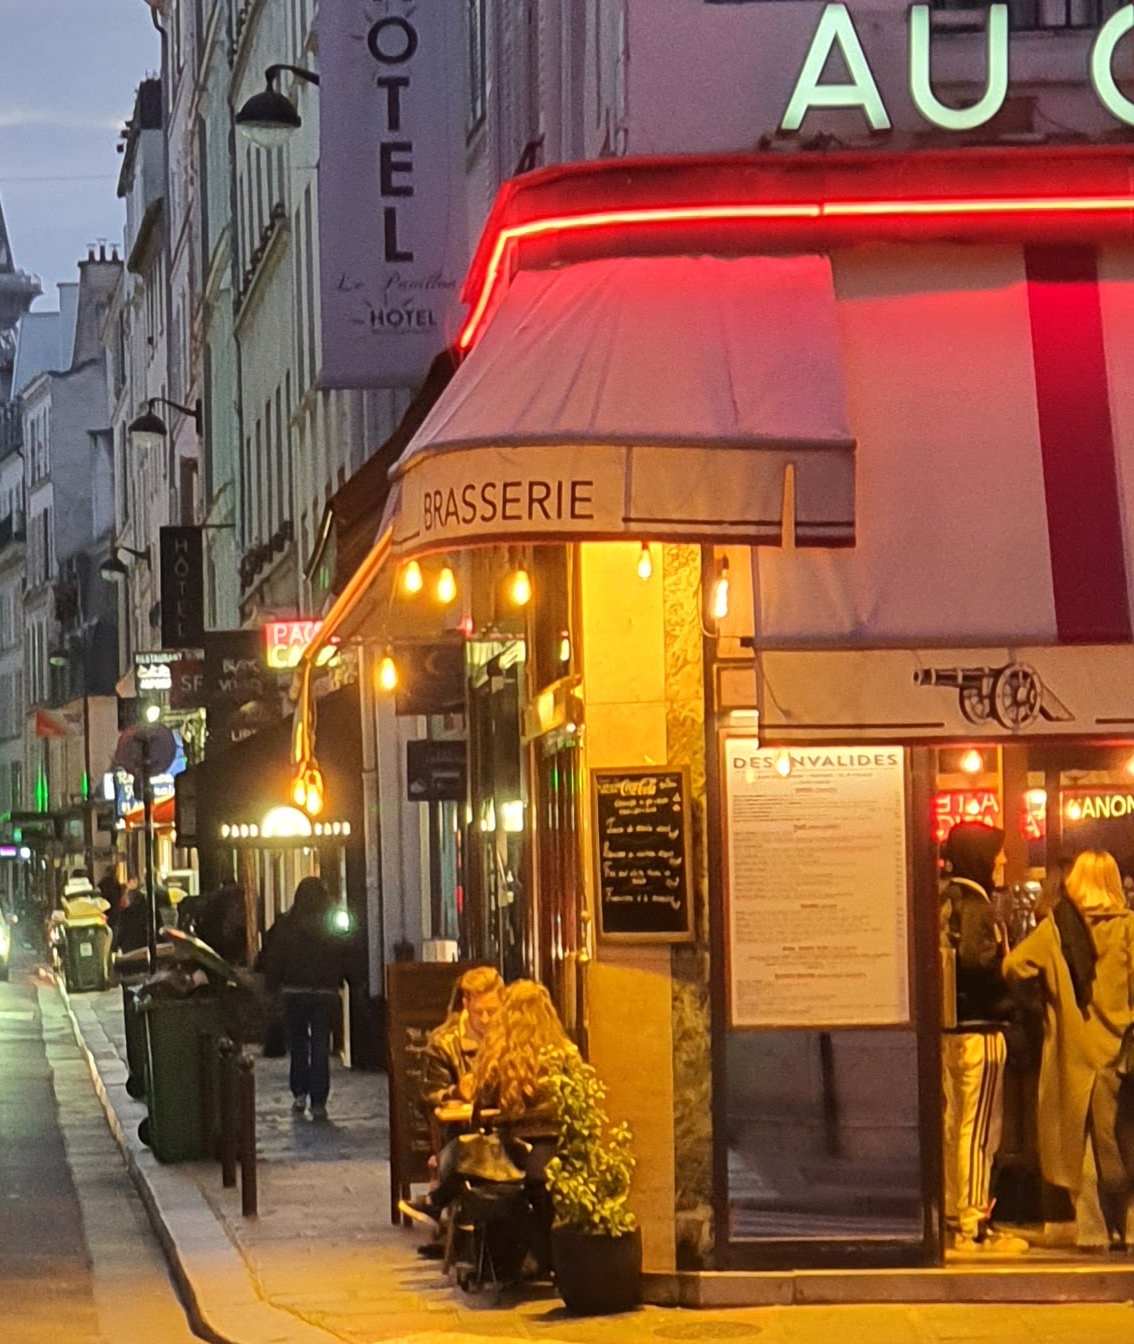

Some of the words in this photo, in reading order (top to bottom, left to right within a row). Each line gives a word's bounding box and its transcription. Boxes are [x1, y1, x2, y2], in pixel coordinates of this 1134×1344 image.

[780, 2, 1009, 131] AU
[370, 309, 438, 327] HOTEL
[424, 480, 595, 532] BRASSERIE
[733, 757, 774, 770] DES
[787, 753, 899, 768] NVALIDES
